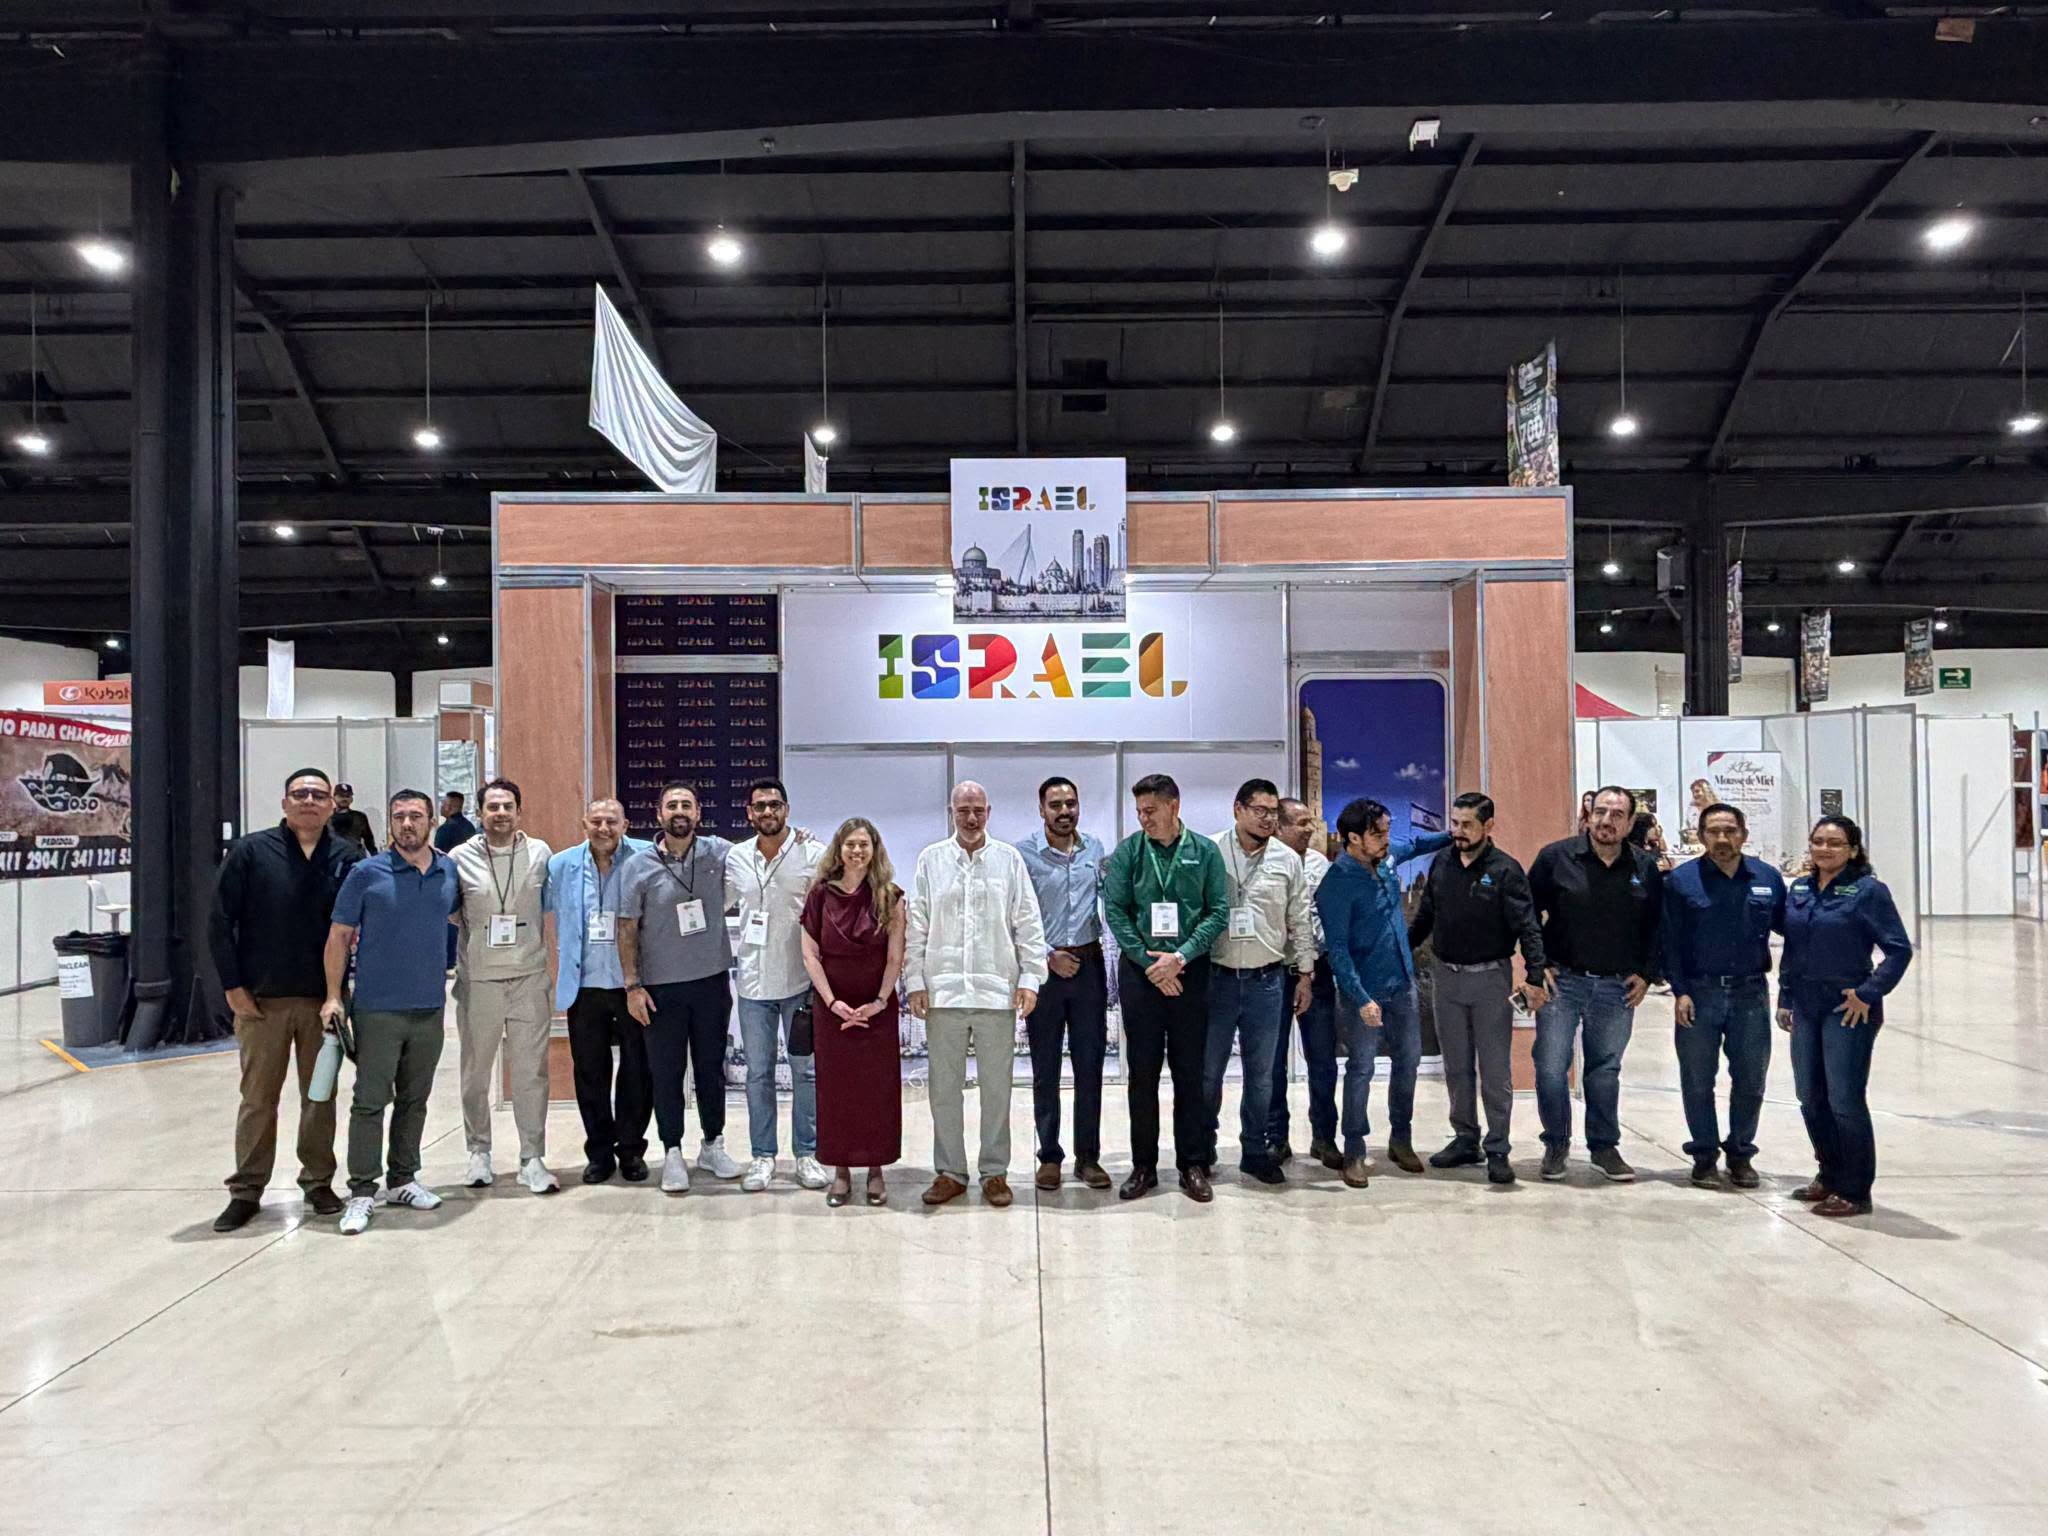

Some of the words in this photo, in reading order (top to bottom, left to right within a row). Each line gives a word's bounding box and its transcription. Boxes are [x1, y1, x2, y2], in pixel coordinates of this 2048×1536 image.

[979, 486, 1096, 511] ISRAEL
[878, 632, 1188, 699] ISRAEL
[85, 687, 129, 700] Kubot
[20, 720, 56, 739] PARA
[26, 850, 58, 870] 2904
[71, 849, 94, 868] 341
[97, 848, 117, 866] 121
